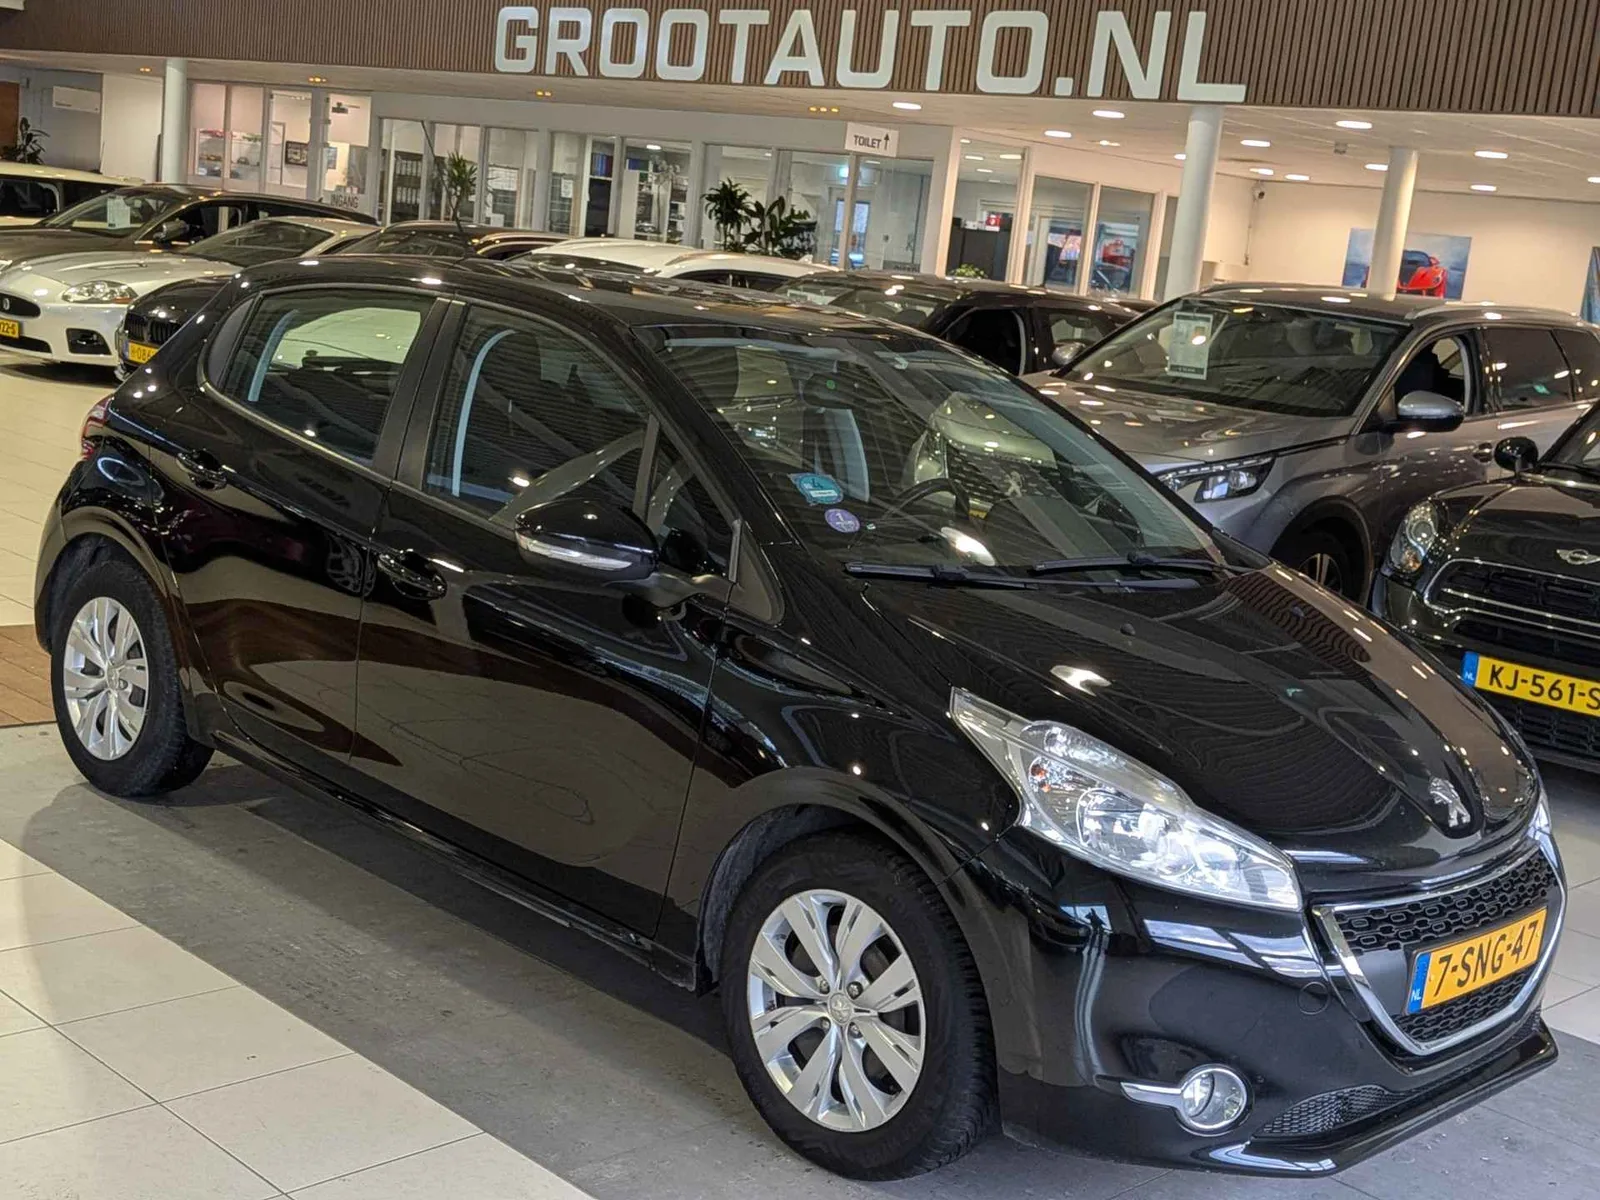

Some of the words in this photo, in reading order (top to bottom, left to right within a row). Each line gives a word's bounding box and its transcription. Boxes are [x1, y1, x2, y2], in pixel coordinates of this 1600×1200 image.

[494, 6, 1247, 103] GROOTAUTO.NL
[853, 134, 882, 149] TOILET
[1433, 920, 1539, 997] 7-SNG-47
[1410, 988, 1422, 1003] NL
